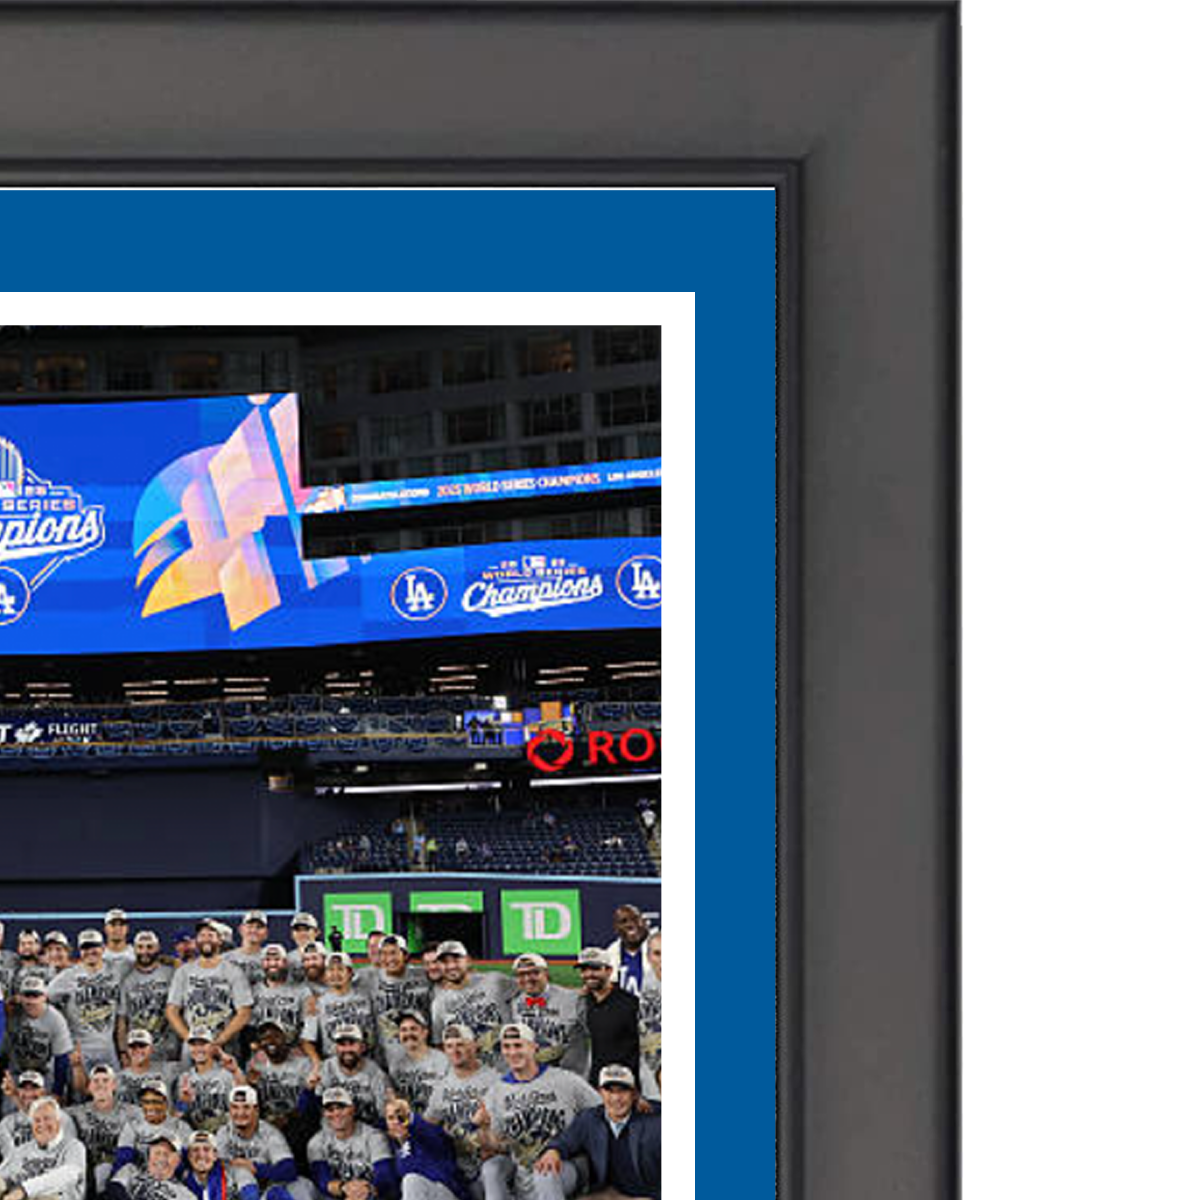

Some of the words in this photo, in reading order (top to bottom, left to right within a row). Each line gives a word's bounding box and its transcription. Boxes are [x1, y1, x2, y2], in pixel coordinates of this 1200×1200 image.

[2, 499, 77, 512] SERIES
[404, 573, 435, 612] LA
[461, 572, 604, 613] Champions
[47, 722, 99, 735] FLIGHT
[331, 903, 386, 940] TD
[510, 901, 572, 940] TD
